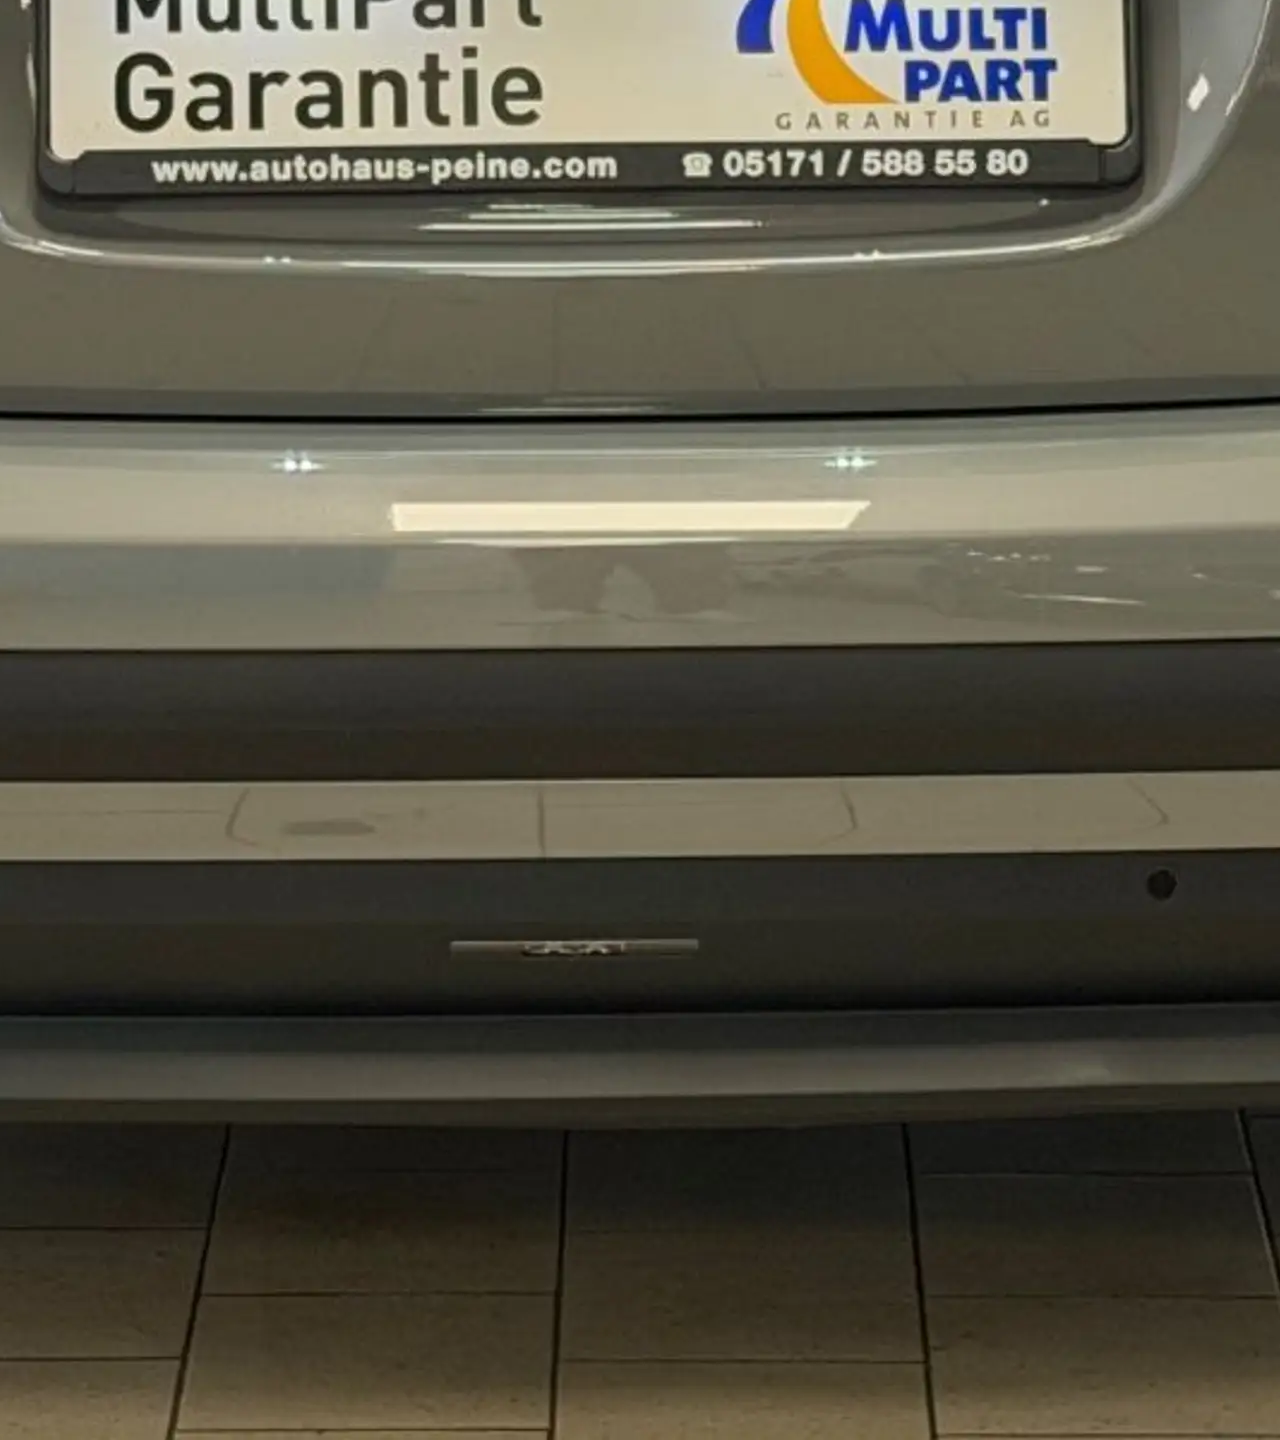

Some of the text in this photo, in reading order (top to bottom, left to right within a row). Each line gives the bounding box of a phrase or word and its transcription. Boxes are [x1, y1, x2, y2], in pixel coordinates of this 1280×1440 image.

[114, 46, 544, 134] Garantie
[905, 59, 1057, 103] PART
[775, 109, 1051, 131] GARANTIE AG
[151, 151, 619, 185] www.autohaus-peine.com
[723, 150, 825, 178] 05171
[861, 149, 926, 177] 588
[934, 149, 978, 176] 55
[986, 148, 1030, 175] 80
